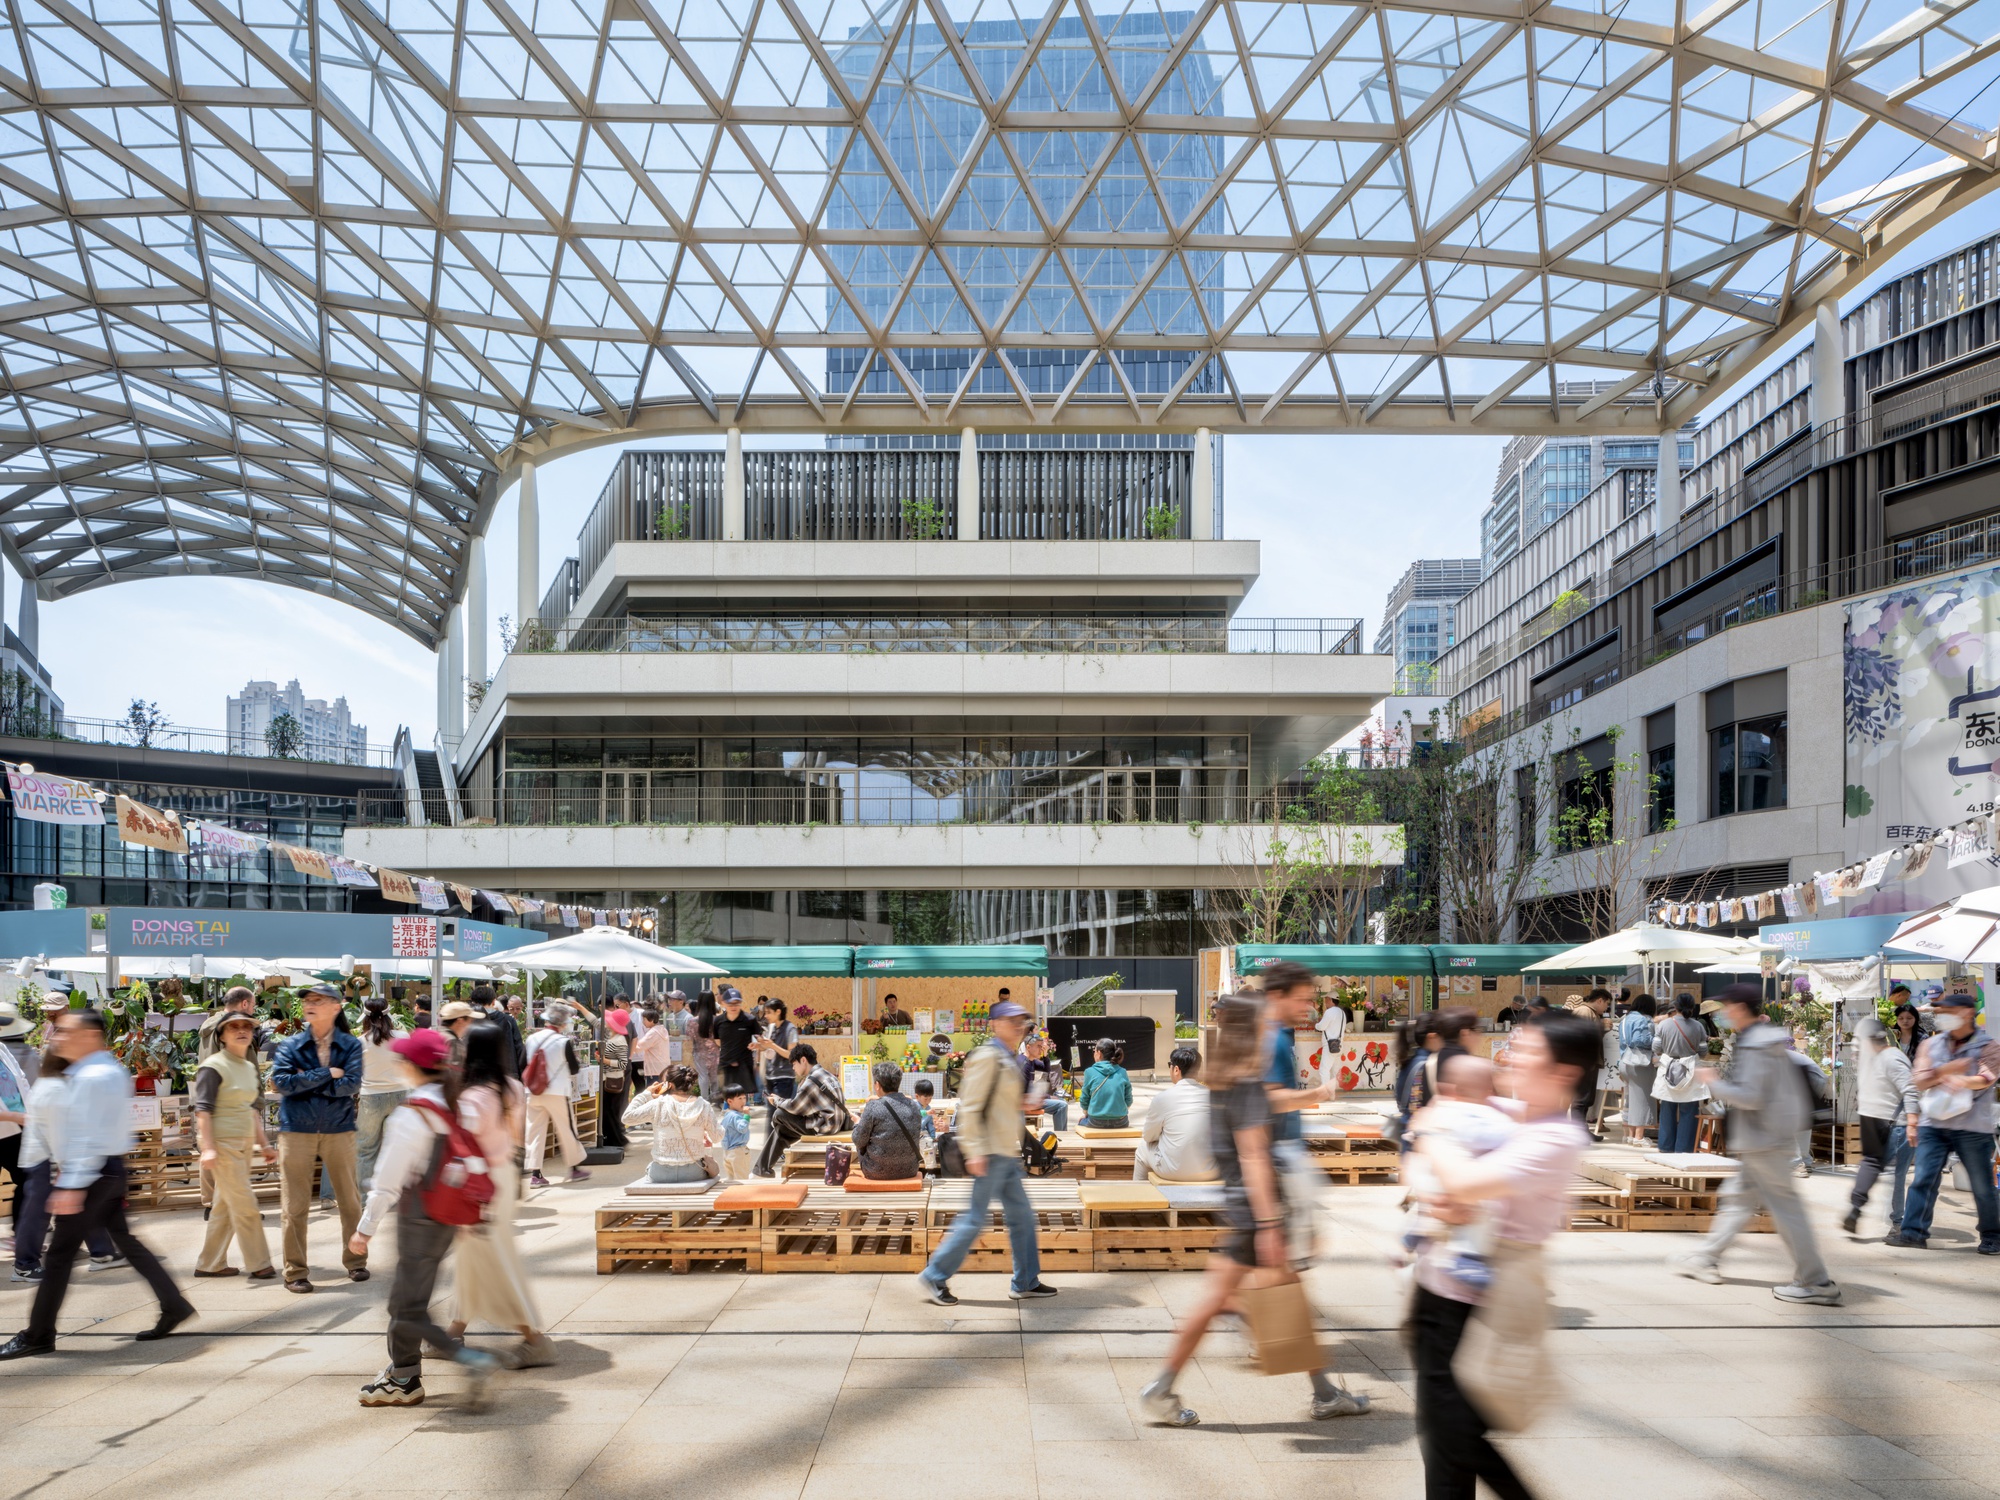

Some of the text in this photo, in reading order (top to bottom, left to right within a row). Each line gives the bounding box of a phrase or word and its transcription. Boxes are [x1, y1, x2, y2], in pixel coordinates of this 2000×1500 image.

[8, 772, 95, 799] DONGTAI
[12, 791, 98, 816] MARKET
[132, 919, 230, 933] DONGTAI
[401, 924, 428, 937] 荒野
[132, 932, 230, 946] MARKET
[463, 928, 493, 942] DONGTAI
[1768, 930, 1811, 943] DONGTAI
[401, 937, 428, 950] 共和
[463, 940, 493, 954] MARKET
